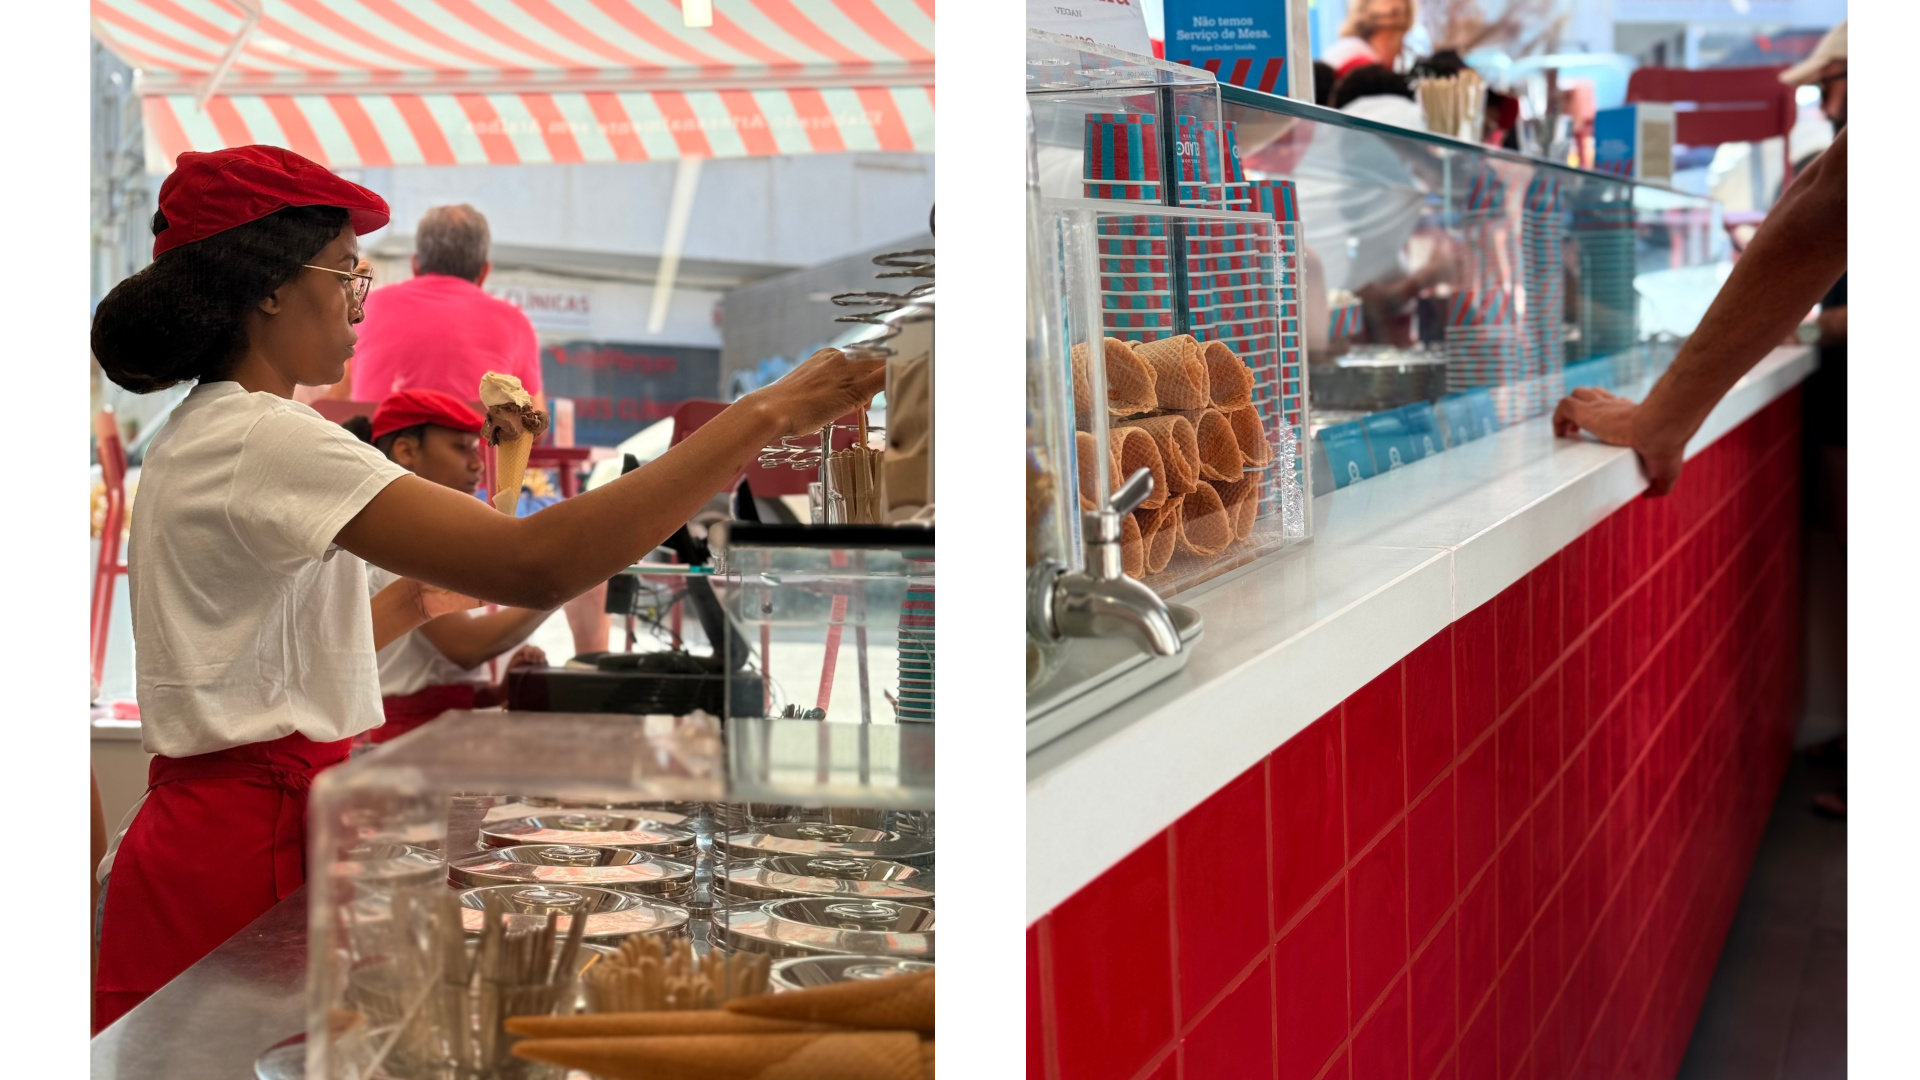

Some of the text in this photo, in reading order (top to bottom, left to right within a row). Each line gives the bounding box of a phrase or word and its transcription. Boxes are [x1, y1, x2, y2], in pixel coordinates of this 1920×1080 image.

[1054, 6, 1082, 17] VEGAN
[1193, 16, 1253, 27] Não temos
[1176, 28, 1271, 41] Serviço de Mesa.
